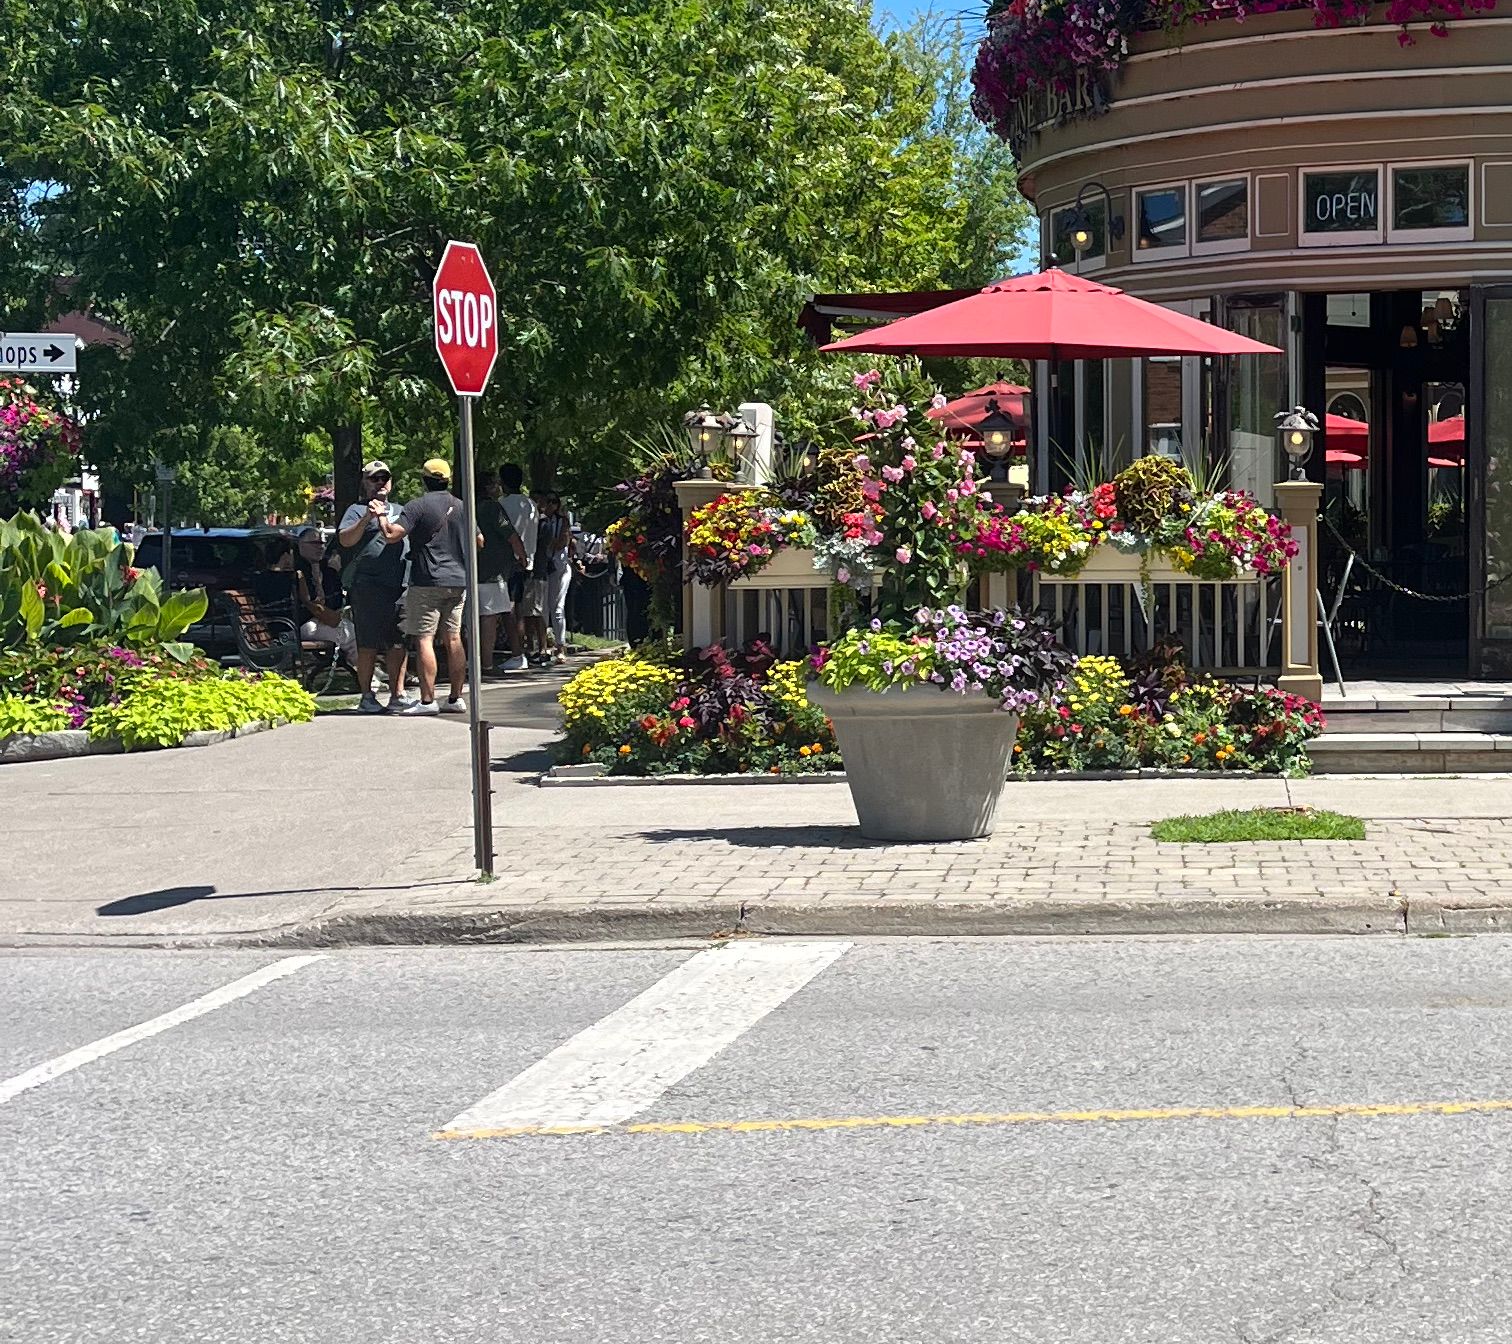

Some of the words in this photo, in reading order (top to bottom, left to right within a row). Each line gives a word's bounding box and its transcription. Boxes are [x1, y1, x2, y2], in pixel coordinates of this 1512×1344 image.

[1046, 67, 1094, 118] BAR
[1316, 192, 1376, 221] OPEN
[438, 288, 493, 348] STOP
[0, 346, 37, 369] ops
